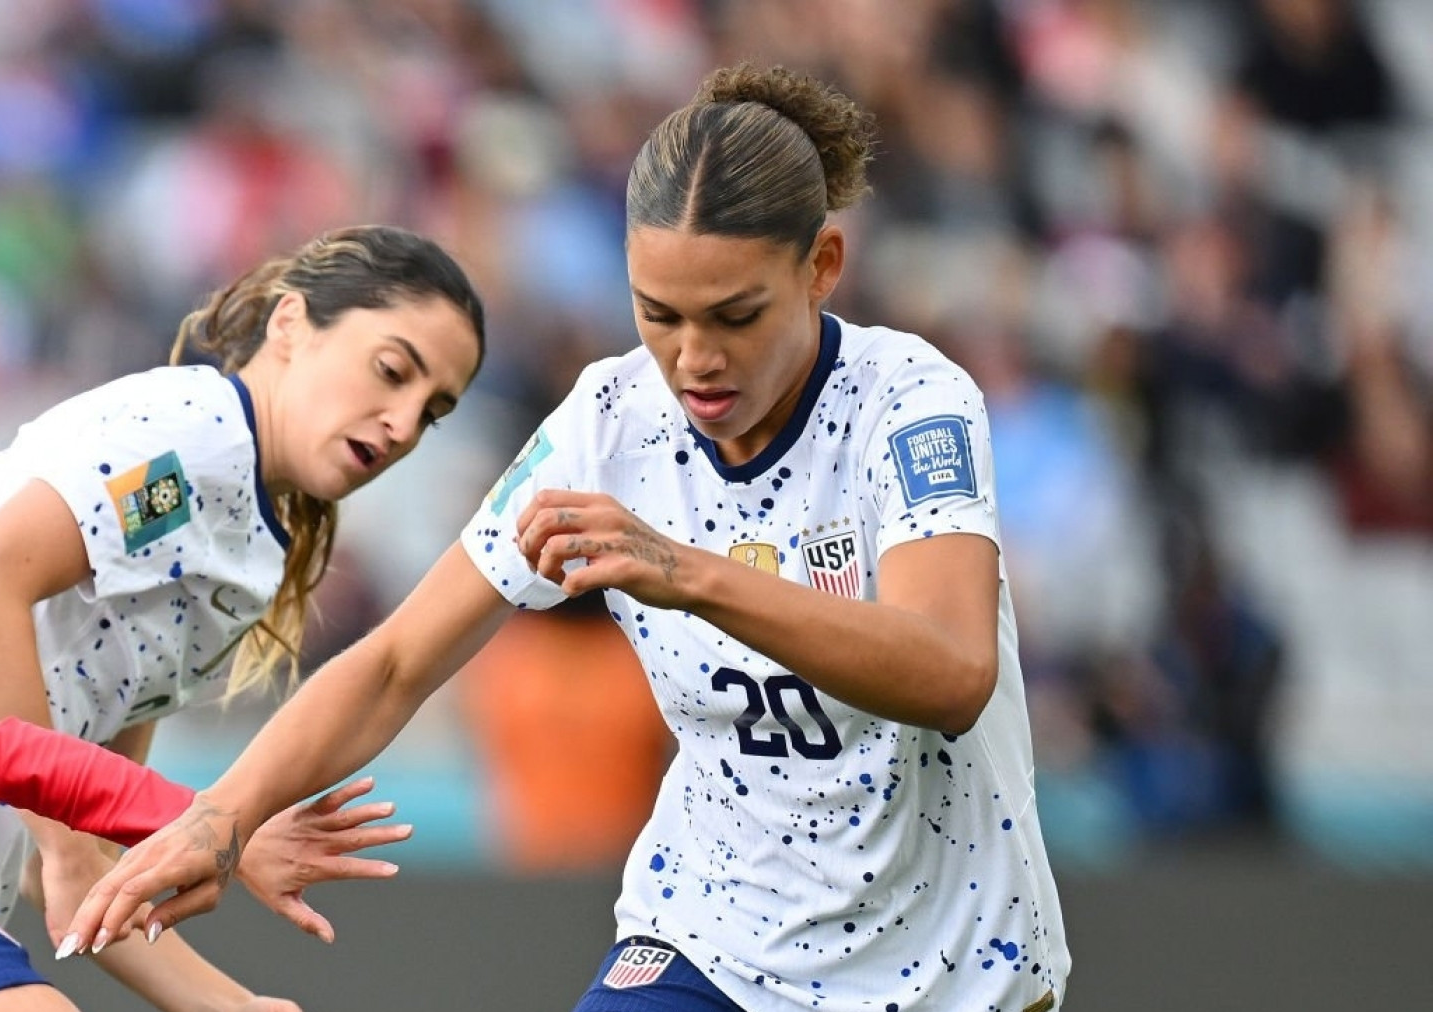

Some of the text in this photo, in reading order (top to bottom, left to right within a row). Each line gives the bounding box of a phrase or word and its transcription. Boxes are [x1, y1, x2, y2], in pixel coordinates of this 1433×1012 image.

[907, 427, 954, 445] FOOTBALL
[910, 438, 957, 460] UNITES
[911, 453, 962, 475] the World
[807, 536, 856, 570] USA
[711, 667, 843, 760] 20
[620, 948, 671, 965] USA
